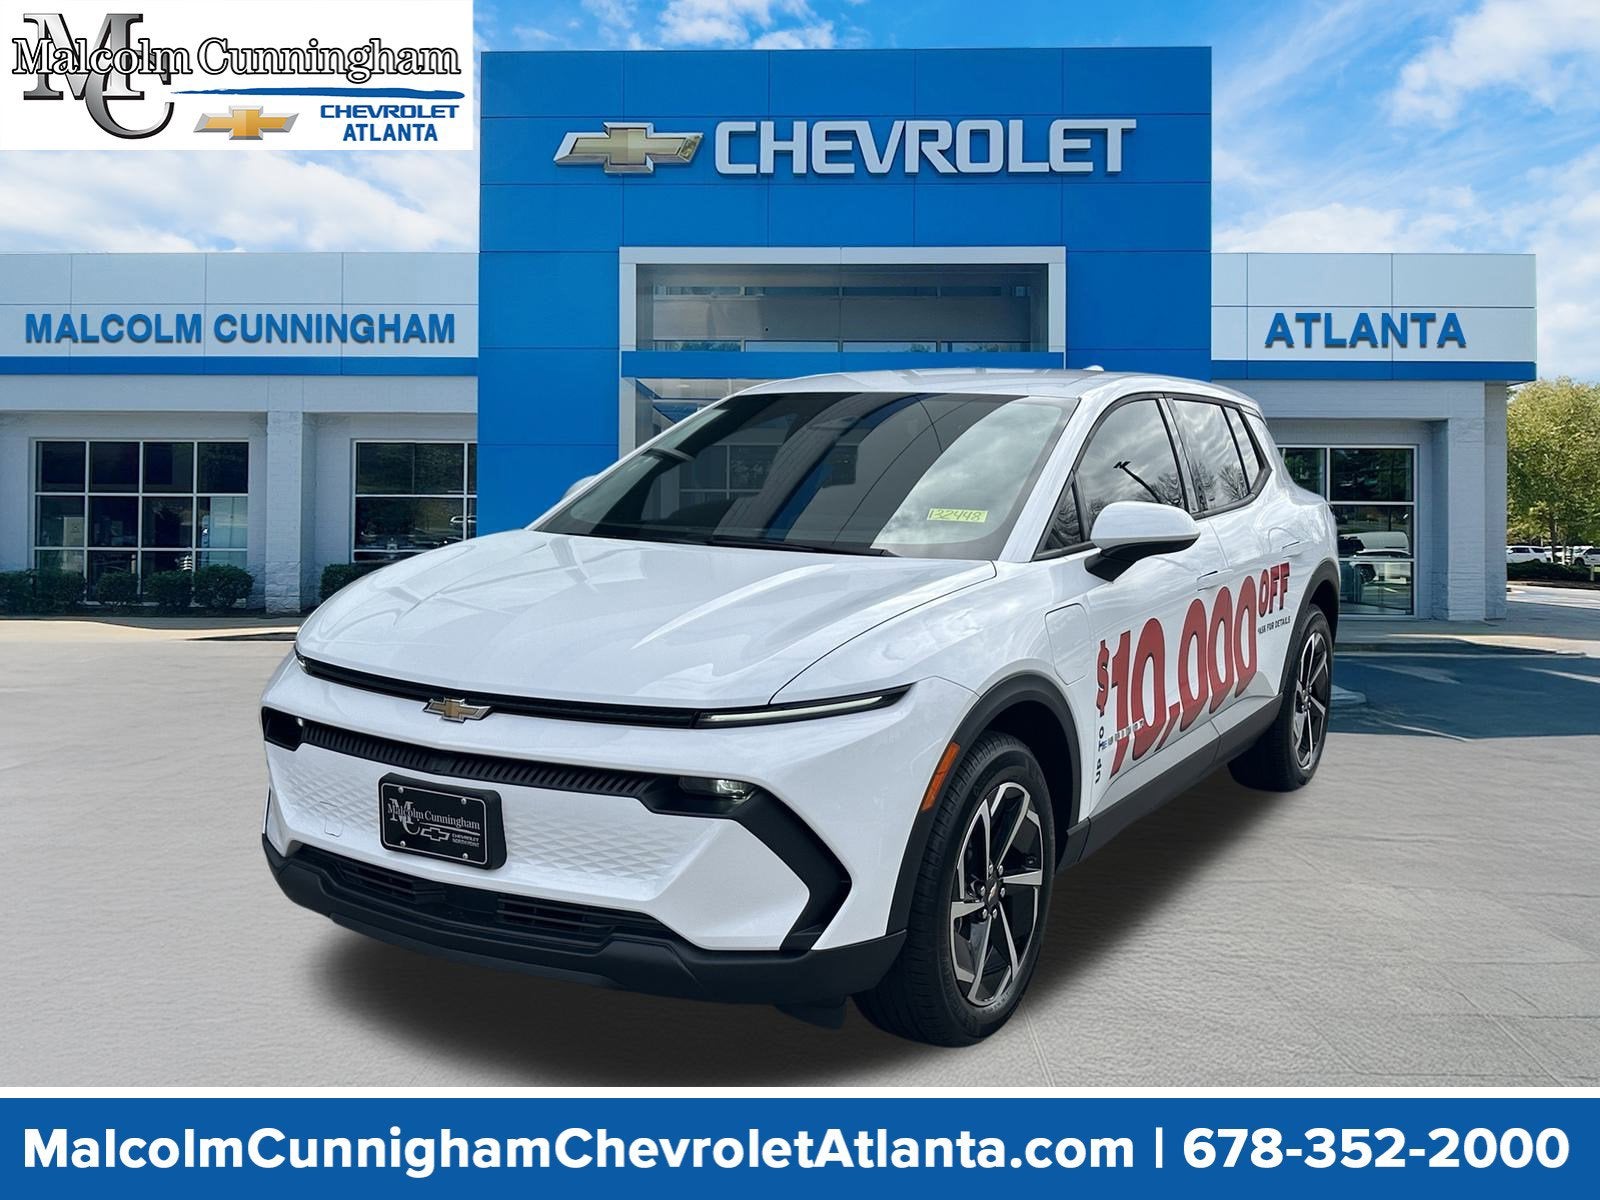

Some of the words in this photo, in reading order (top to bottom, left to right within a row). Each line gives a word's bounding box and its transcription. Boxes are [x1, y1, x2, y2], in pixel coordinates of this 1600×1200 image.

[715, 119, 1137, 175] CHEVROLET
[25, 313, 202, 344] MALCOLM
[213, 313, 456, 344] CUNNINGHAM
[1264, 312, 1467, 349] ATLANTA
[1258, 561, 1290, 618] OFF
[1096, 574, 1258, 780] $10,000
[387, 802, 424, 820] Malcolm
[424, 809, 481, 831] Cunningham
